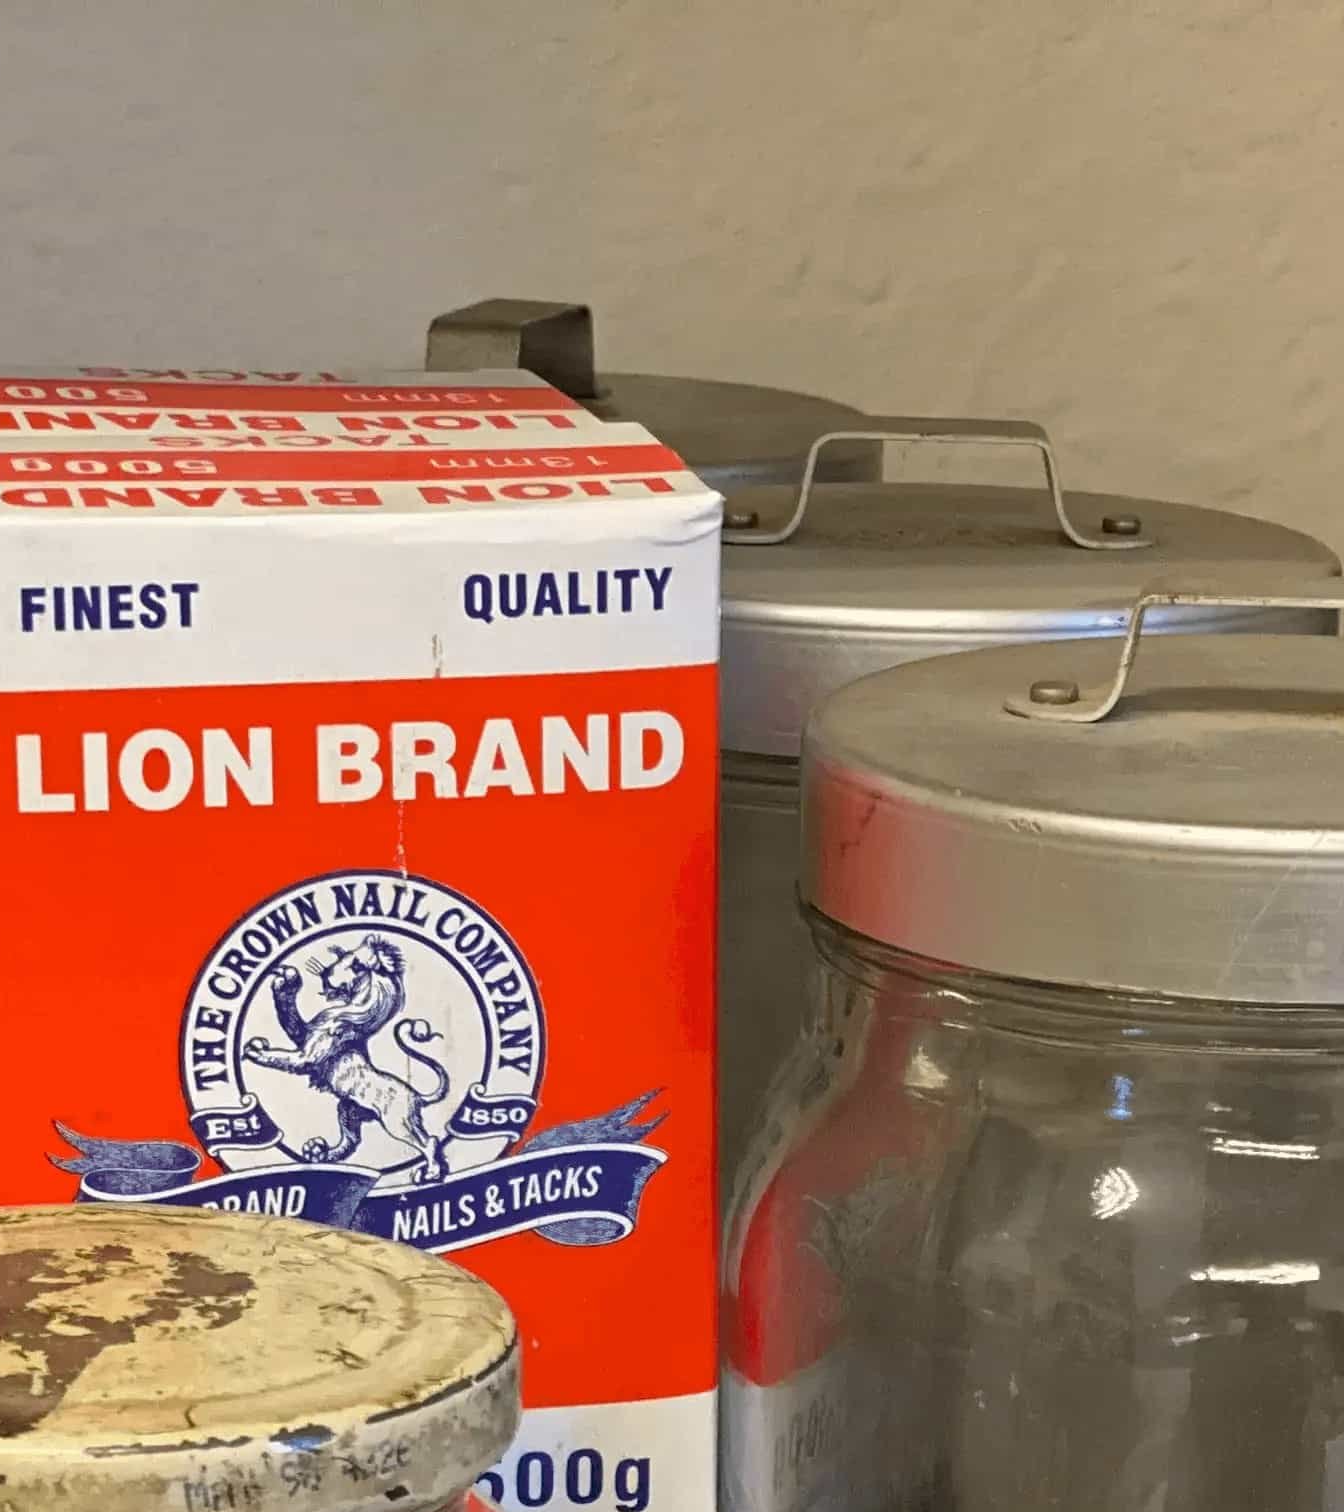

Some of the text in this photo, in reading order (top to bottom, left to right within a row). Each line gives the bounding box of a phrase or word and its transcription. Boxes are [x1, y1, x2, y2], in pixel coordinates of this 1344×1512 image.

[336, 414, 577, 431] LION
[149, 433, 450, 448] TACKS
[9, 454, 609, 475] 13mm 500g
[0, 477, 676, 508] LION BRAND
[19, 565, 674, 632] FINEST QUALITY
[15, 709, 687, 815] LION BRAND
[192, 881, 535, 1092] THE CROWN NAIL COMPANY
[205, 1112, 262, 1141] Est
[459, 1103, 529, 1129] 1850
[199, 1183, 308, 1218] RAND
[391, 1190, 477, 1244] NAILS
